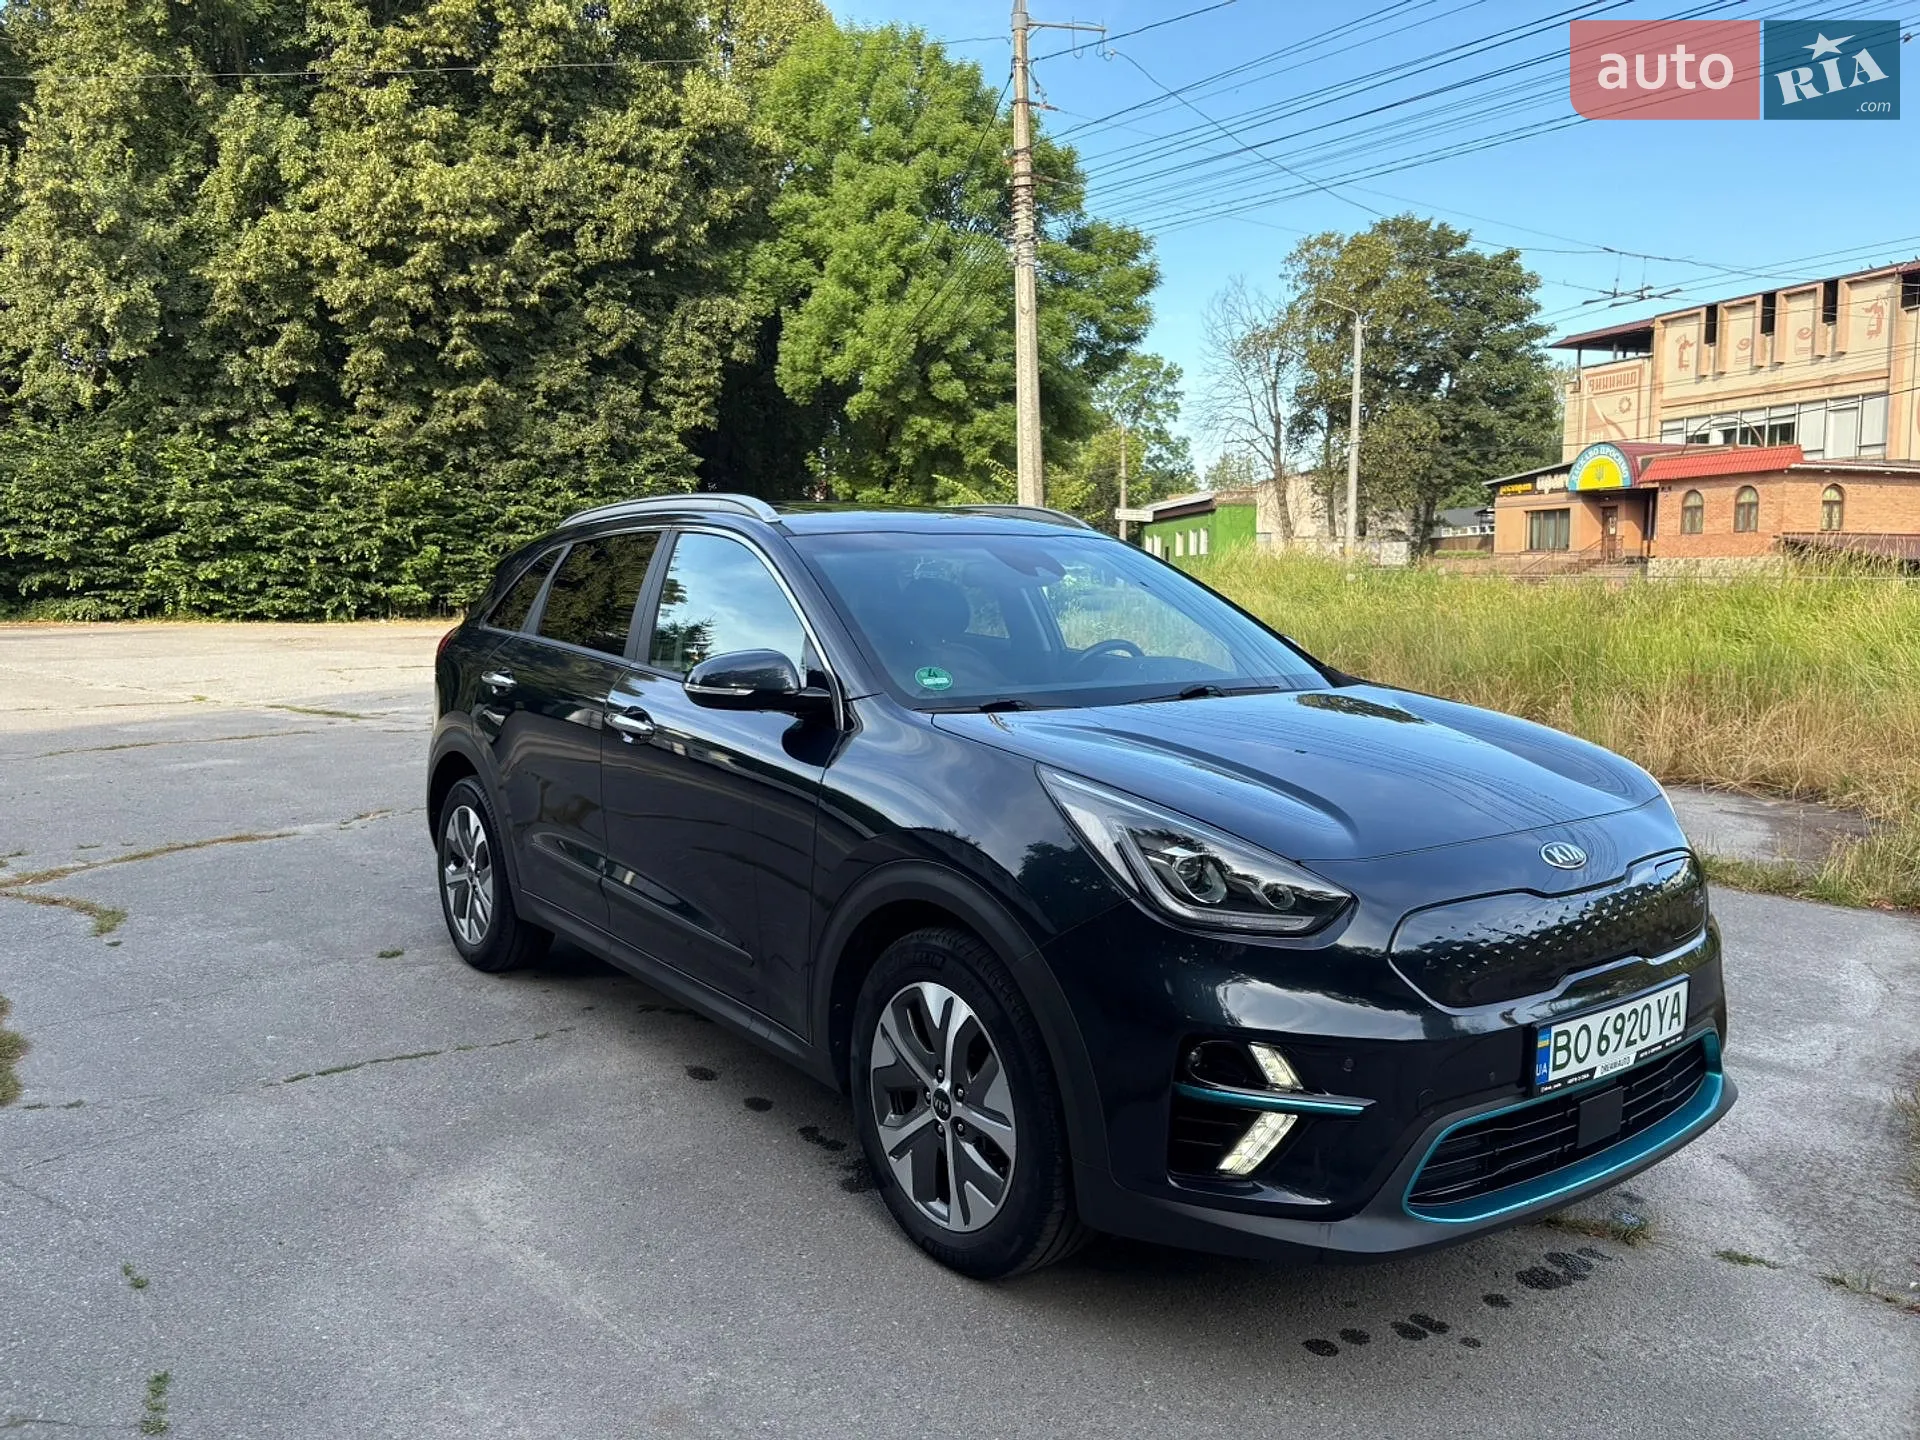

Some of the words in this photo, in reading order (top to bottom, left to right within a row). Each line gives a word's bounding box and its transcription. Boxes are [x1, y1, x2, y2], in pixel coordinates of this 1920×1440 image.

[1546, 845, 1584, 864] KIA
[1552, 1022, 1592, 1072] BO
[1598, 1003, 1652, 1057] 6920
[1657, 991, 1682, 1036] YA
[1535, 1063, 1548, 1077] UA
